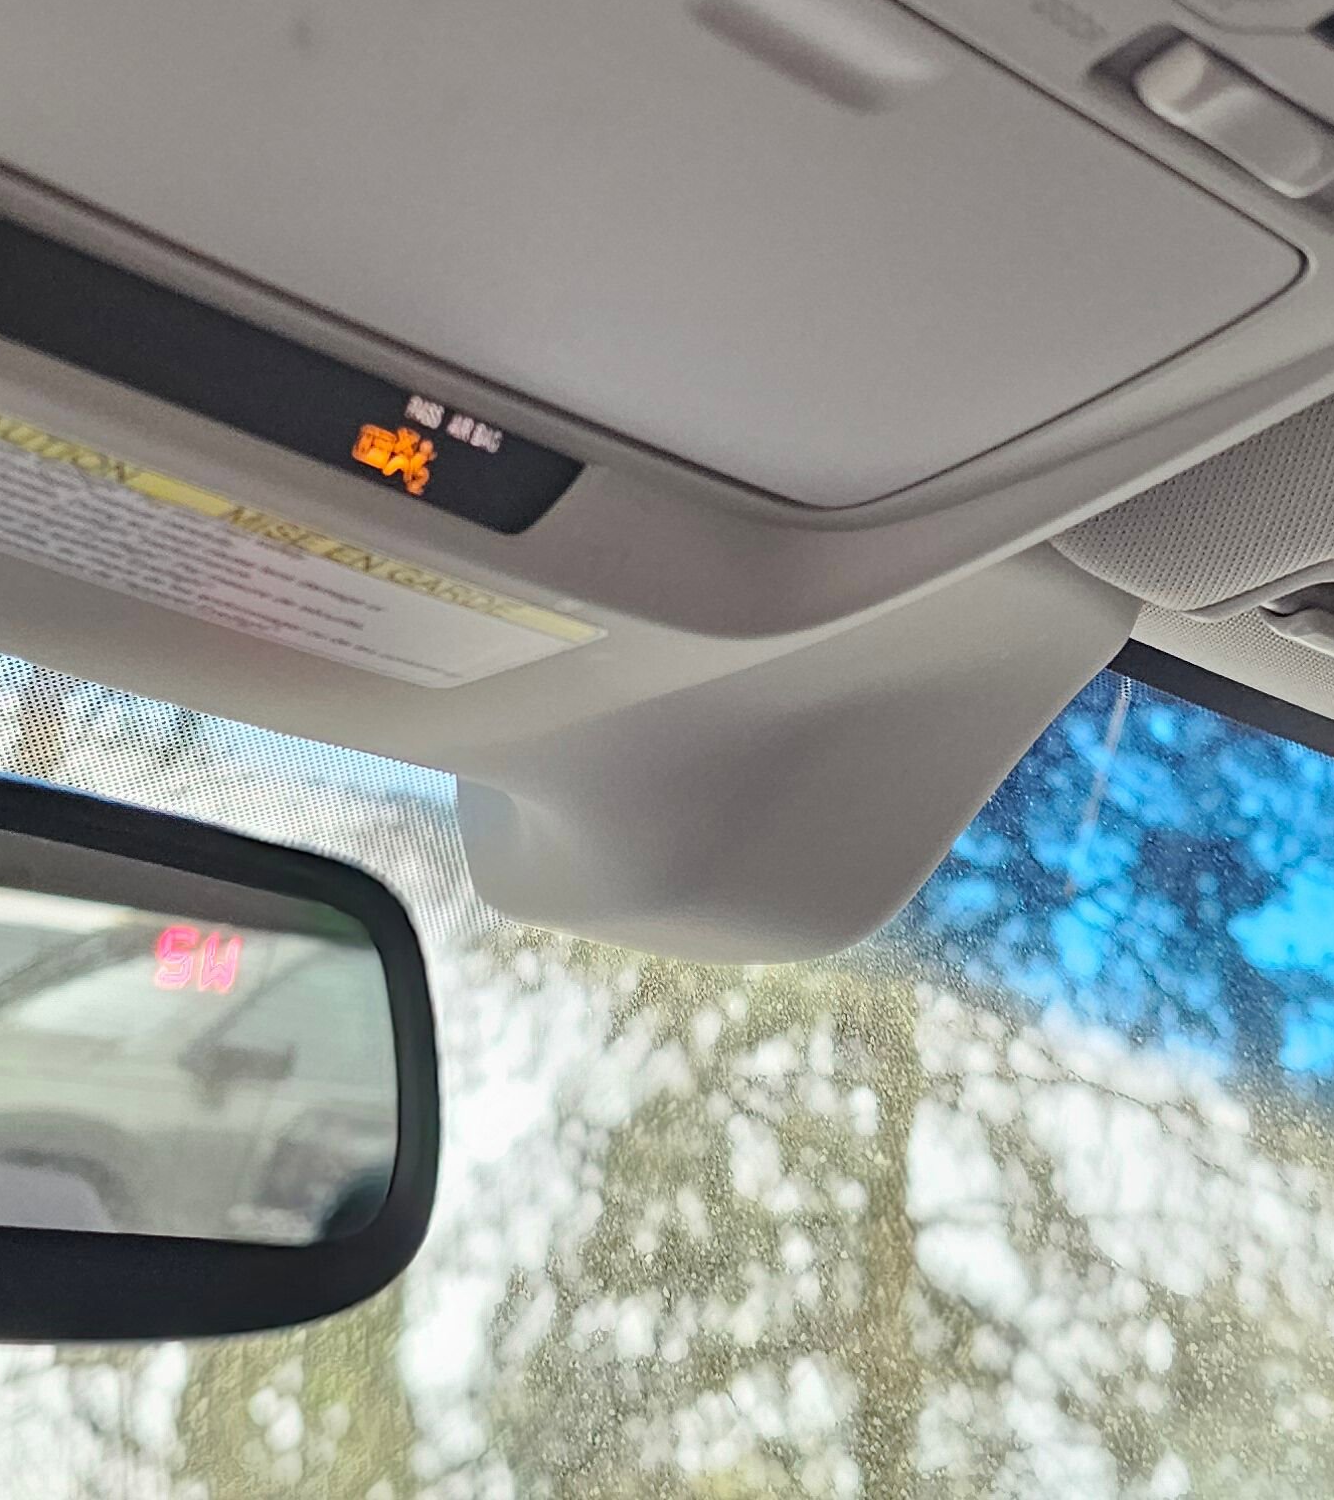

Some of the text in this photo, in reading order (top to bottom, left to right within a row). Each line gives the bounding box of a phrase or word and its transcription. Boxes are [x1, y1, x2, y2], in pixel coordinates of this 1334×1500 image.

[225, 505, 328, 552] MISE
[326, 546, 386, 575] EN
[154, 924, 243, 994] SW
